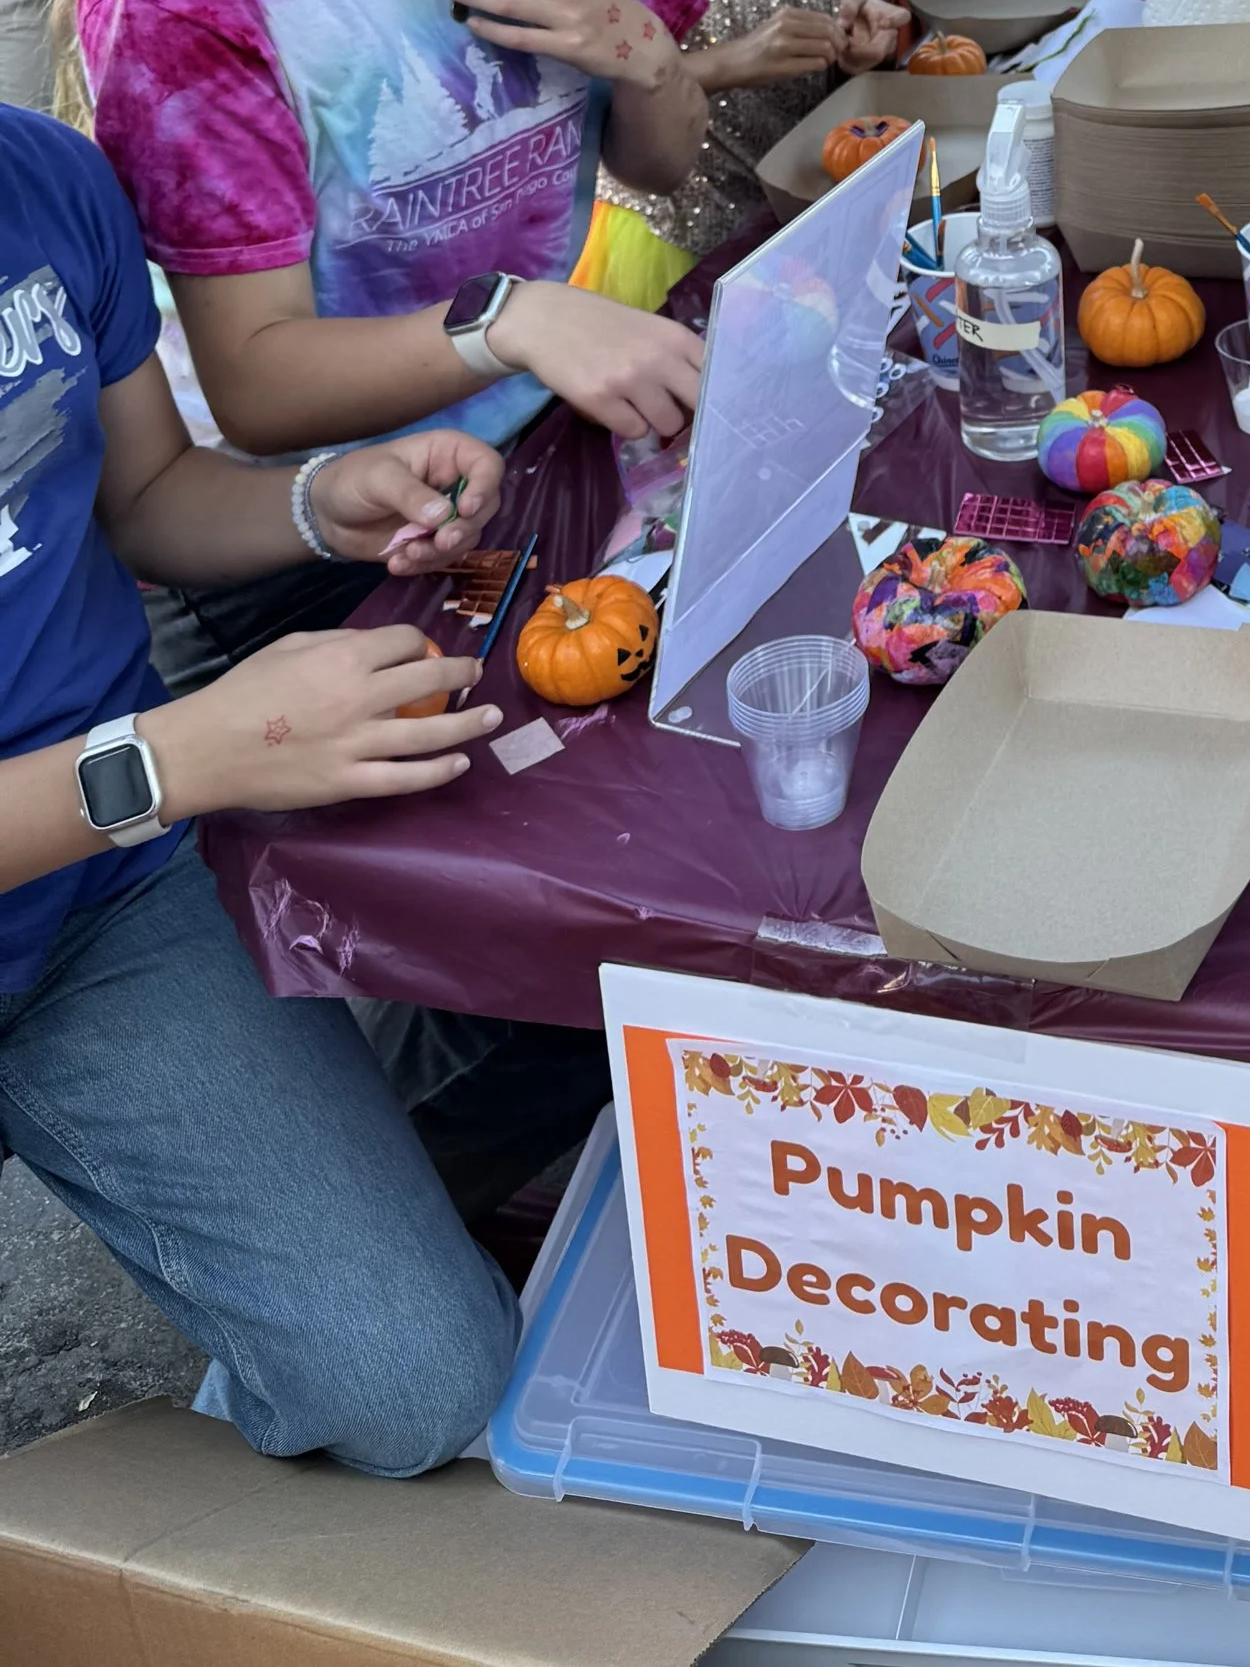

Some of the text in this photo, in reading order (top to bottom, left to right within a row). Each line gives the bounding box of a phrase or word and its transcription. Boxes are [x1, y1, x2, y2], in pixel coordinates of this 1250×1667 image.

[351, 120, 582, 233] RAINTREE RAN
[386, 238, 418, 252] The
[424, 220, 469, 246] YMCA
[472, 210, 488, 229] of
[491, 197, 513, 222] San
[552, 167, 578, 185] Cou
[959, 315, 984, 343] TER
[771, 1140, 1131, 1261] Pumpkin
[726, 1236, 1190, 1392] Decorating
